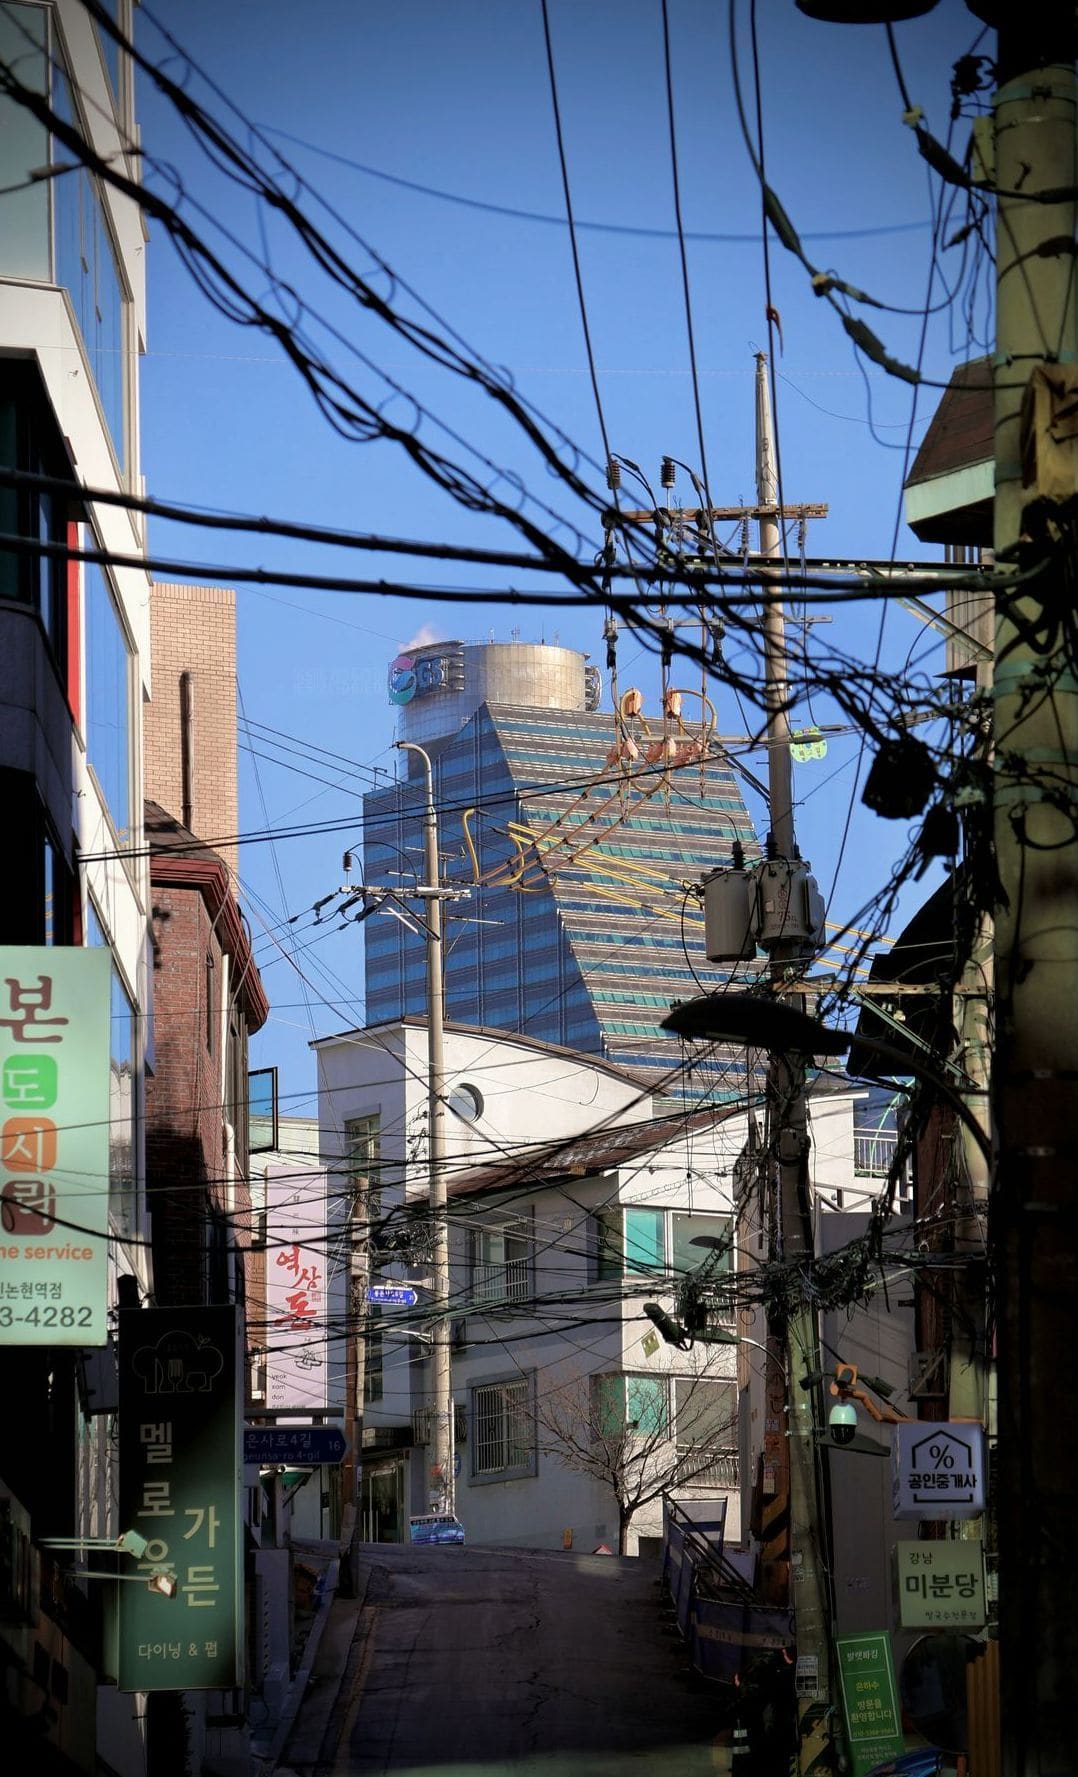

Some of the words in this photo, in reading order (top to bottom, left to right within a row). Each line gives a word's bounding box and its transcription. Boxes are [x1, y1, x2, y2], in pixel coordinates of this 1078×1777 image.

[417, 658, 447, 687] GS
[24, 1243, 93, 1260] service
[328, 1440, 341, 1451] 16
[908, 1473, 977, 1489] 공인중개사
[182, 1506, 220, 1606] 가든
[909, 1551, 933, 1565] 강남
[905, 1573, 979, 1599] 미분당
[138, 1642, 182, 1660] 다이닝
[188, 1643, 198, 1657] &
[850, 1709, 894, 1723] 환영합니다
